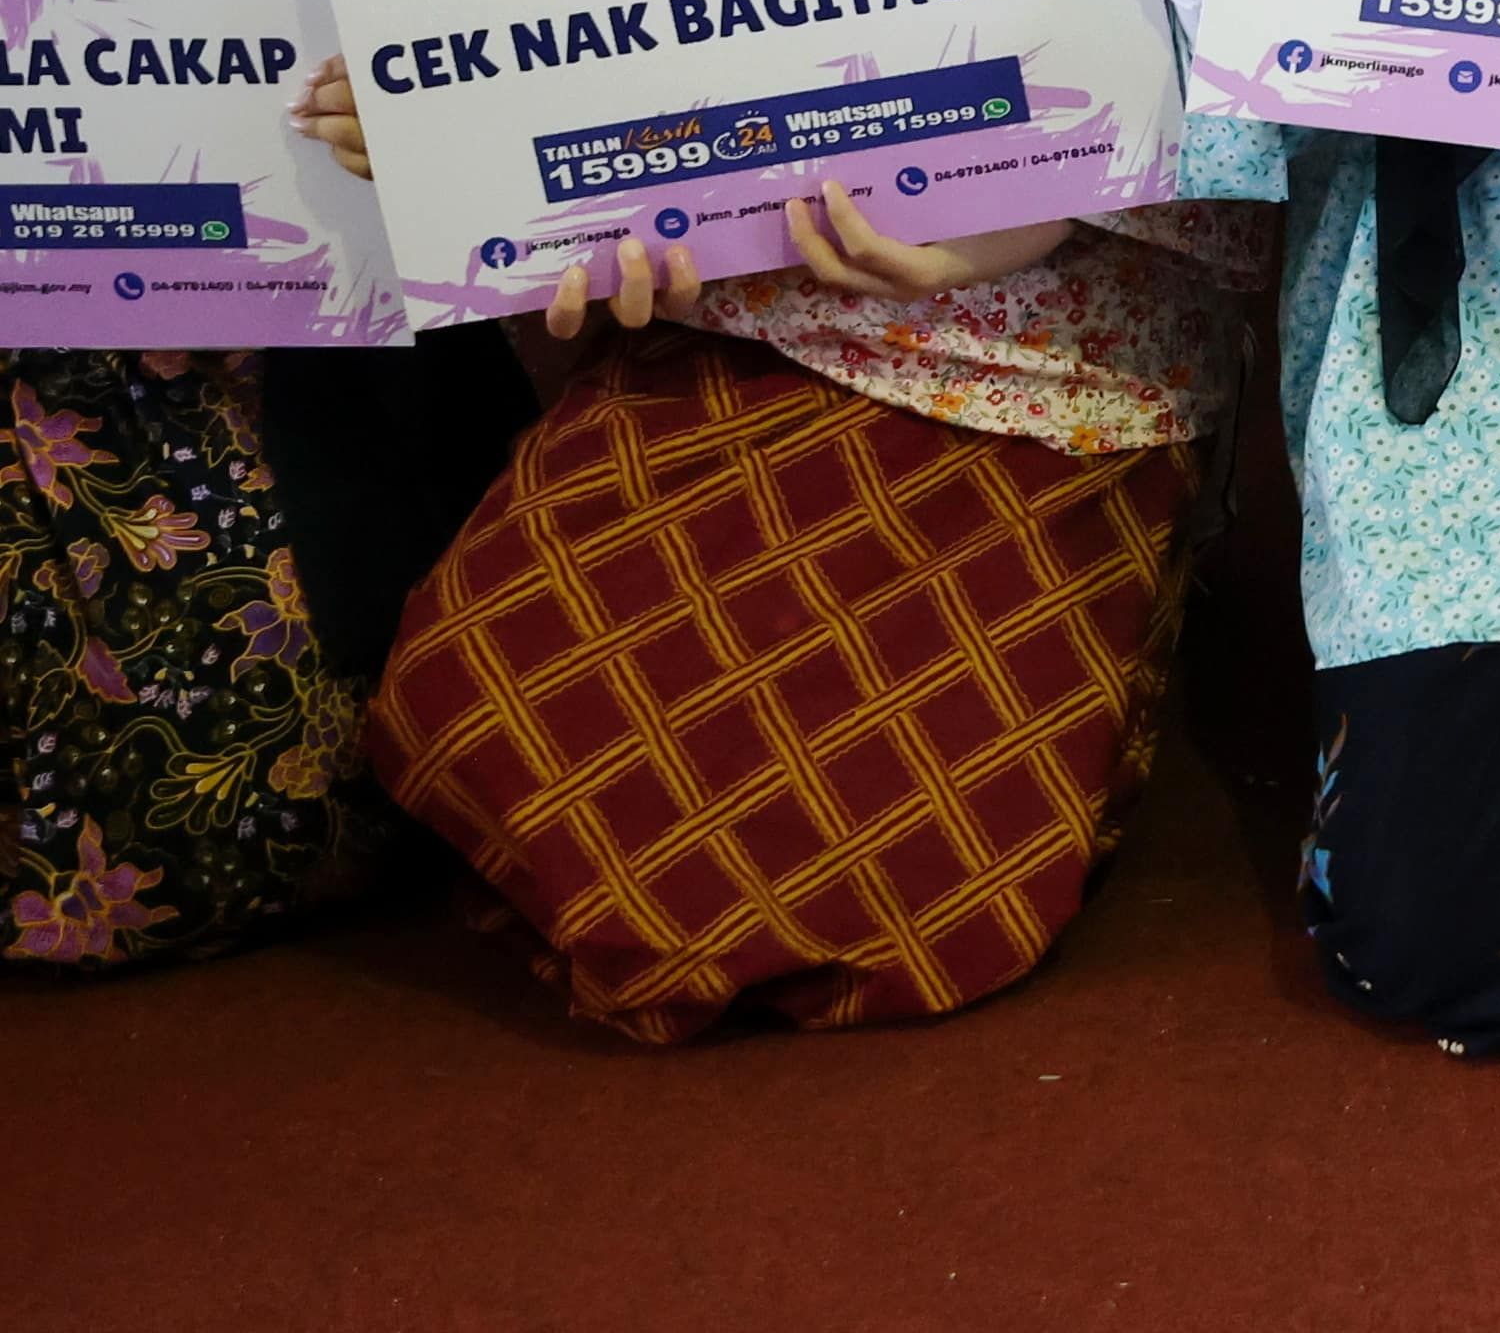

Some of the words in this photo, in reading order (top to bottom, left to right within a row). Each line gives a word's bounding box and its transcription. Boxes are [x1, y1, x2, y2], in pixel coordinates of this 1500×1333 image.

[80, 36, 300, 86] CAKAP
[367, 27, 502, 97] CEK
[509, 1, 660, 73] NAK
[784, 93, 915, 135] Whatsapp
[789, 129, 835, 151] 019
[848, 121, 884, 141] 26
[892, 104, 978, 133] 15999
[542, 135, 623, 164] TALIAN
[734, 123, 776, 150] 24
[547, 139, 713, 193] 15999
[10, 202, 136, 224] Whatsapp
[13, 225, 57, 239] 019
[71, 224, 105, 239] 26
[113, 224, 197, 238] 15999
